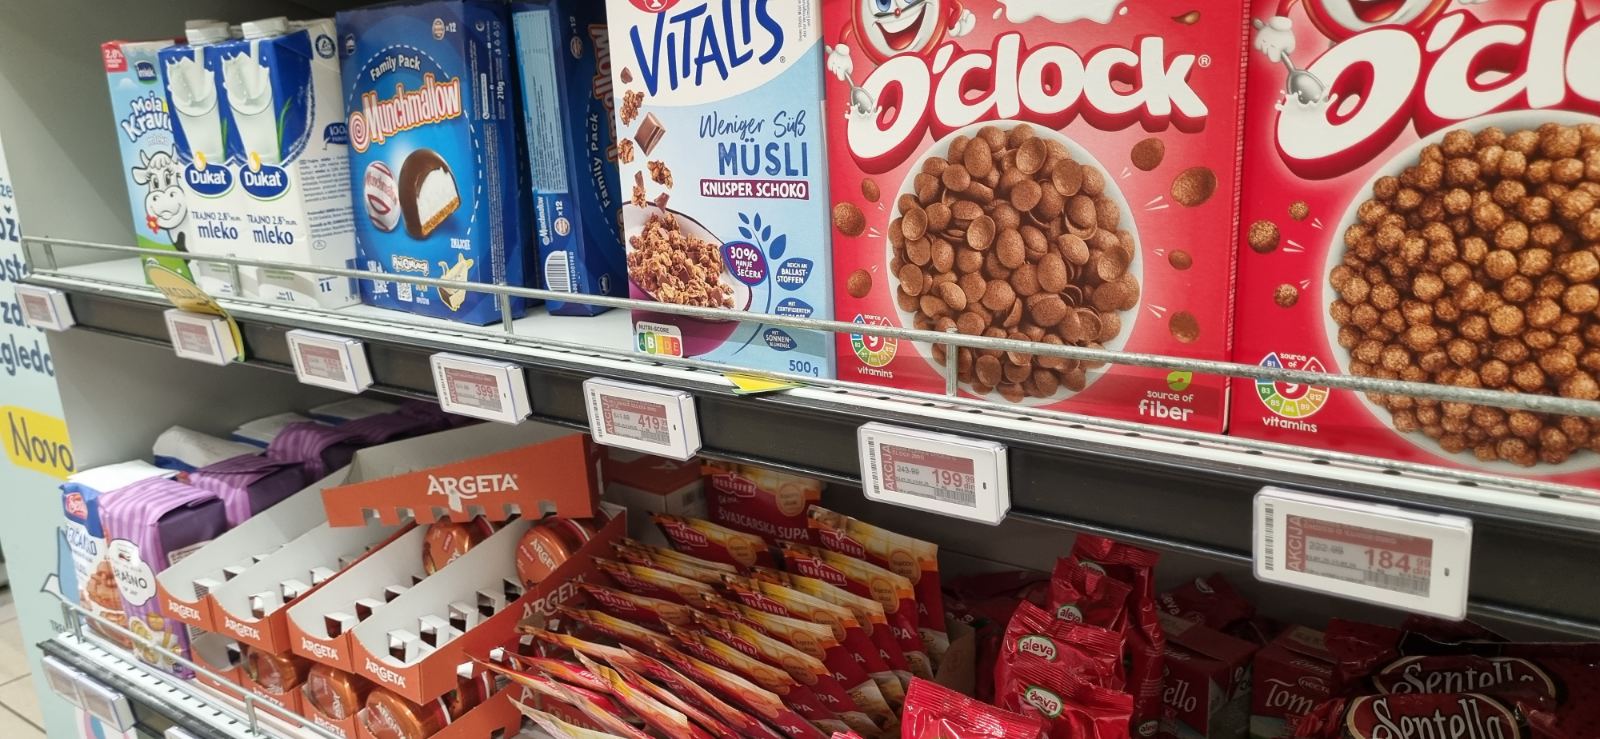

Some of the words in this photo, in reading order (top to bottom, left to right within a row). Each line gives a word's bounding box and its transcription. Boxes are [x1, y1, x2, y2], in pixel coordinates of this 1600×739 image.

[369, 56, 397, 81] Family
[398, 54, 421, 71] Pack
[497, 81, 506, 100] 210g
[362, 72, 461, 144] Munchmallow
[590, 112, 599, 151] Pack
[699, 111, 765, 140] Weniger
[773, 110, 807, 138] Süß
[718, 138, 809, 177] MÜSLI
[189, 169, 227, 184] Dukat
[243, 171, 282, 187] Dukat
[593, 157, 611, 209] Family
[702, 180, 753, 197] KNUSPER
[755, 181, 807, 199] SCHOKO
[197, 220, 238, 240] mleko
[252, 225, 294, 245] mleko
[730, 246, 759, 262] 30%
[777, 275, 804, 284] STOFFEN
[781, 268, 808, 277] BALLAST-
[319, 281, 333, 293] 1L
[647, 336, 655, 349] B
[1280, 353, 1307, 361] source
[789, 360, 811, 374] 500
[813, 367, 819, 377] g
[857, 366, 894, 379] vitamins
[480, 388, 501, 402] 399
[1147, 390, 1180, 401] source
[1182, 394, 1195, 403] of
[1139, 399, 1194, 422] fiber
[638, 414, 660, 430] 419
[1262, 416, 1318, 433] vitamins
[8, 411, 75, 473] Novo
[882, 446, 895, 490] AKCIJA
[427, 473, 519, 500] ARGETA
[931, 469, 963, 488] 199
[777, 526, 810, 540] SUPA
[1288, 517, 1303, 571] AKCIJA
[530, 538, 557, 572] ARGET
[1364, 549, 1411, 573] 184
[224, 616, 261, 641] ARGETA
[301, 636, 340, 661] ARGETA
[1022, 638, 1054, 657] aleva
[365, 657, 406, 689] ARGETA
[1162, 679, 1197, 713] ello
[1263, 678, 1314, 716] Tom
[1372, 697, 1504, 739] Sentella
